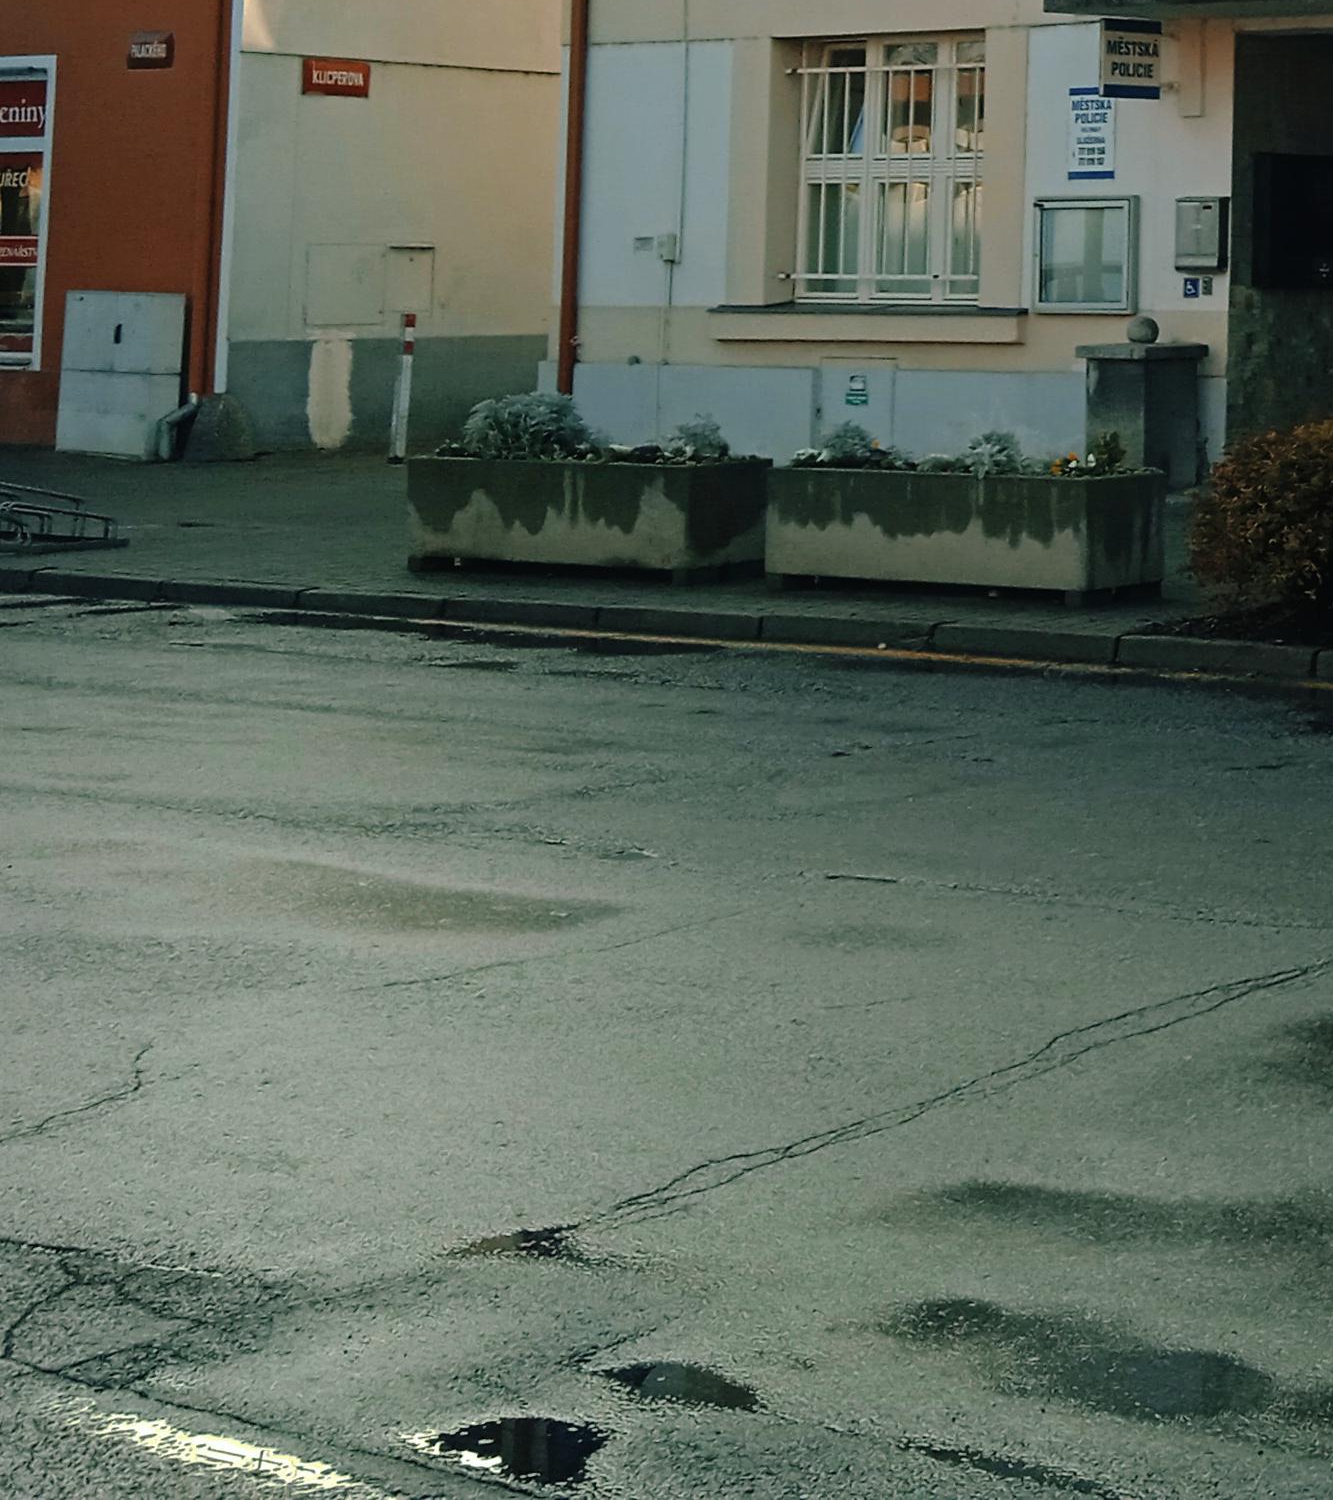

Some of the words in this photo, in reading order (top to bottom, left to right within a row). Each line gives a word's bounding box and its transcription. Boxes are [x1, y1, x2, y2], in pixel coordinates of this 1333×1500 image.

[1106, 36, 1159, 57] MĚSTSKÁ
[312, 69, 364, 86] KLICPEROVA
[1111, 61, 1154, 78] POLICIE
[1074, 112, 1108, 124] POLICIE
